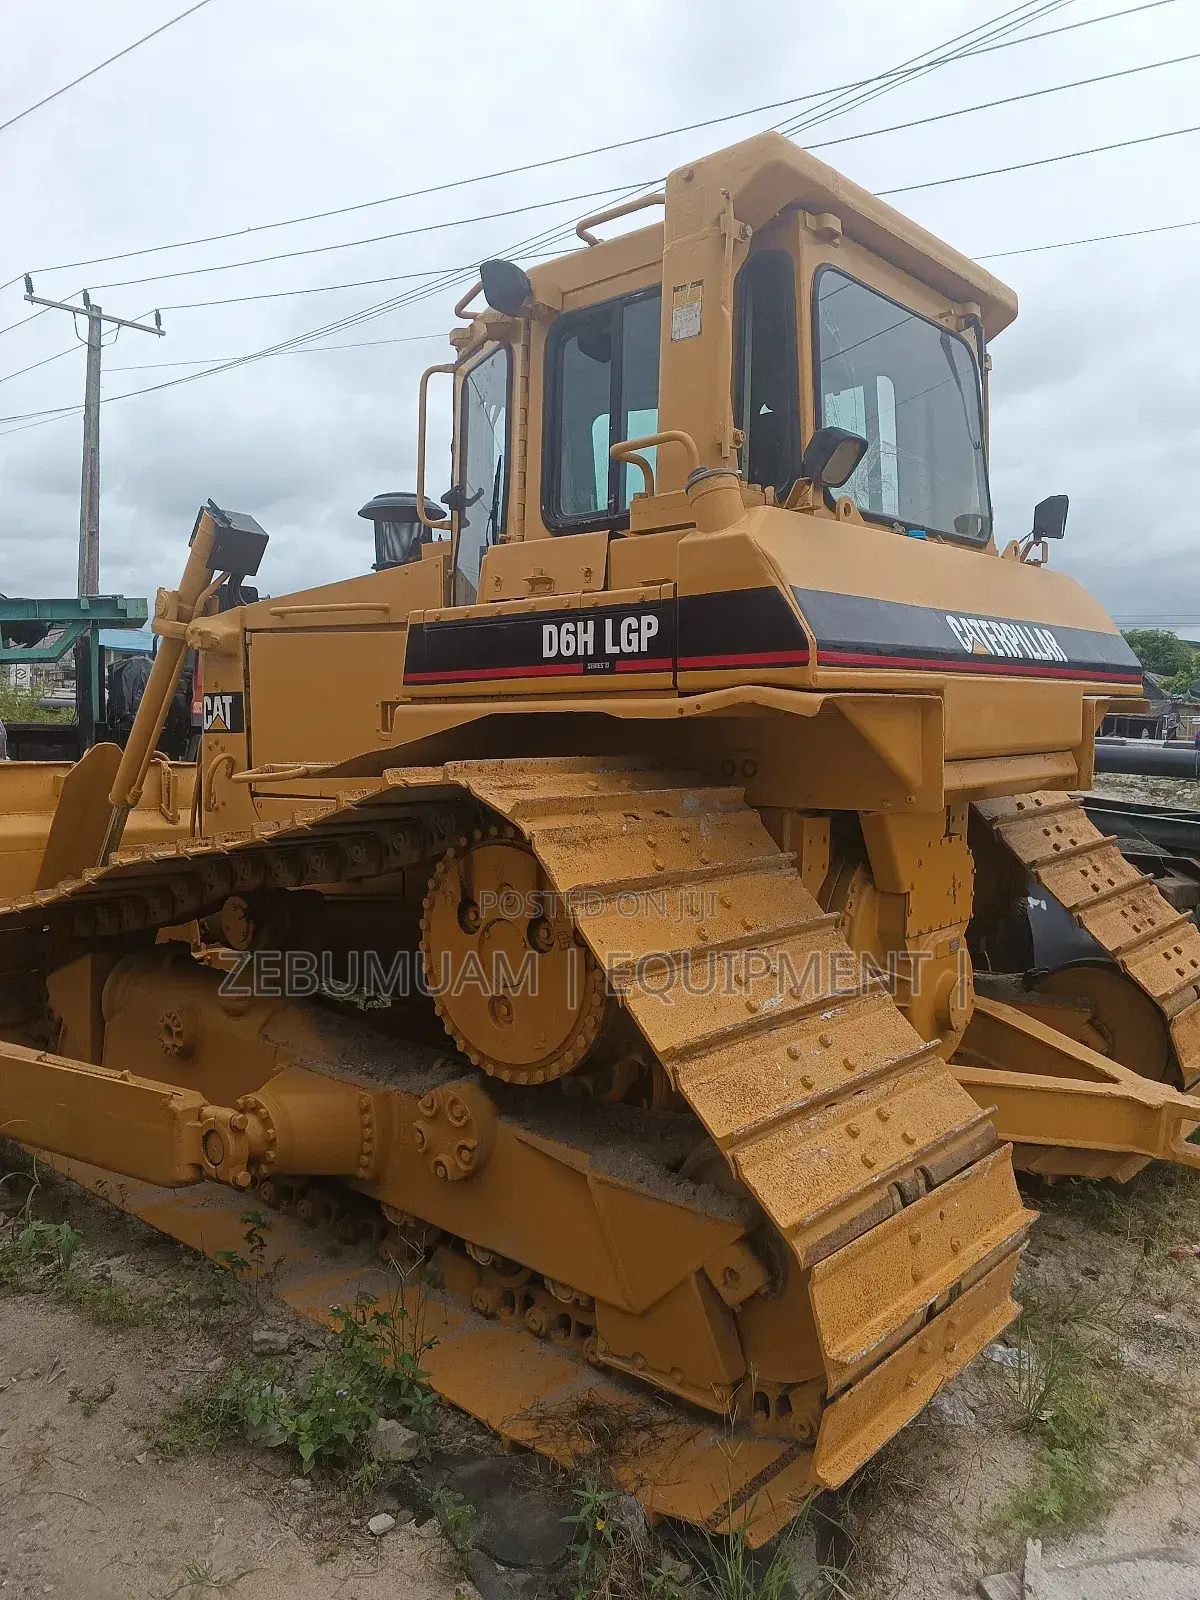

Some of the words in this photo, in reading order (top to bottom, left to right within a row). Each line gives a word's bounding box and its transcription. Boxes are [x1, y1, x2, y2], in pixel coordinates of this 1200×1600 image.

[542, 621, 595, 658] D6H
[605, 614, 659, 654] LGP
[945, 614, 1069, 663] CATERPILLAR
[203, 695, 232, 730] CAT
